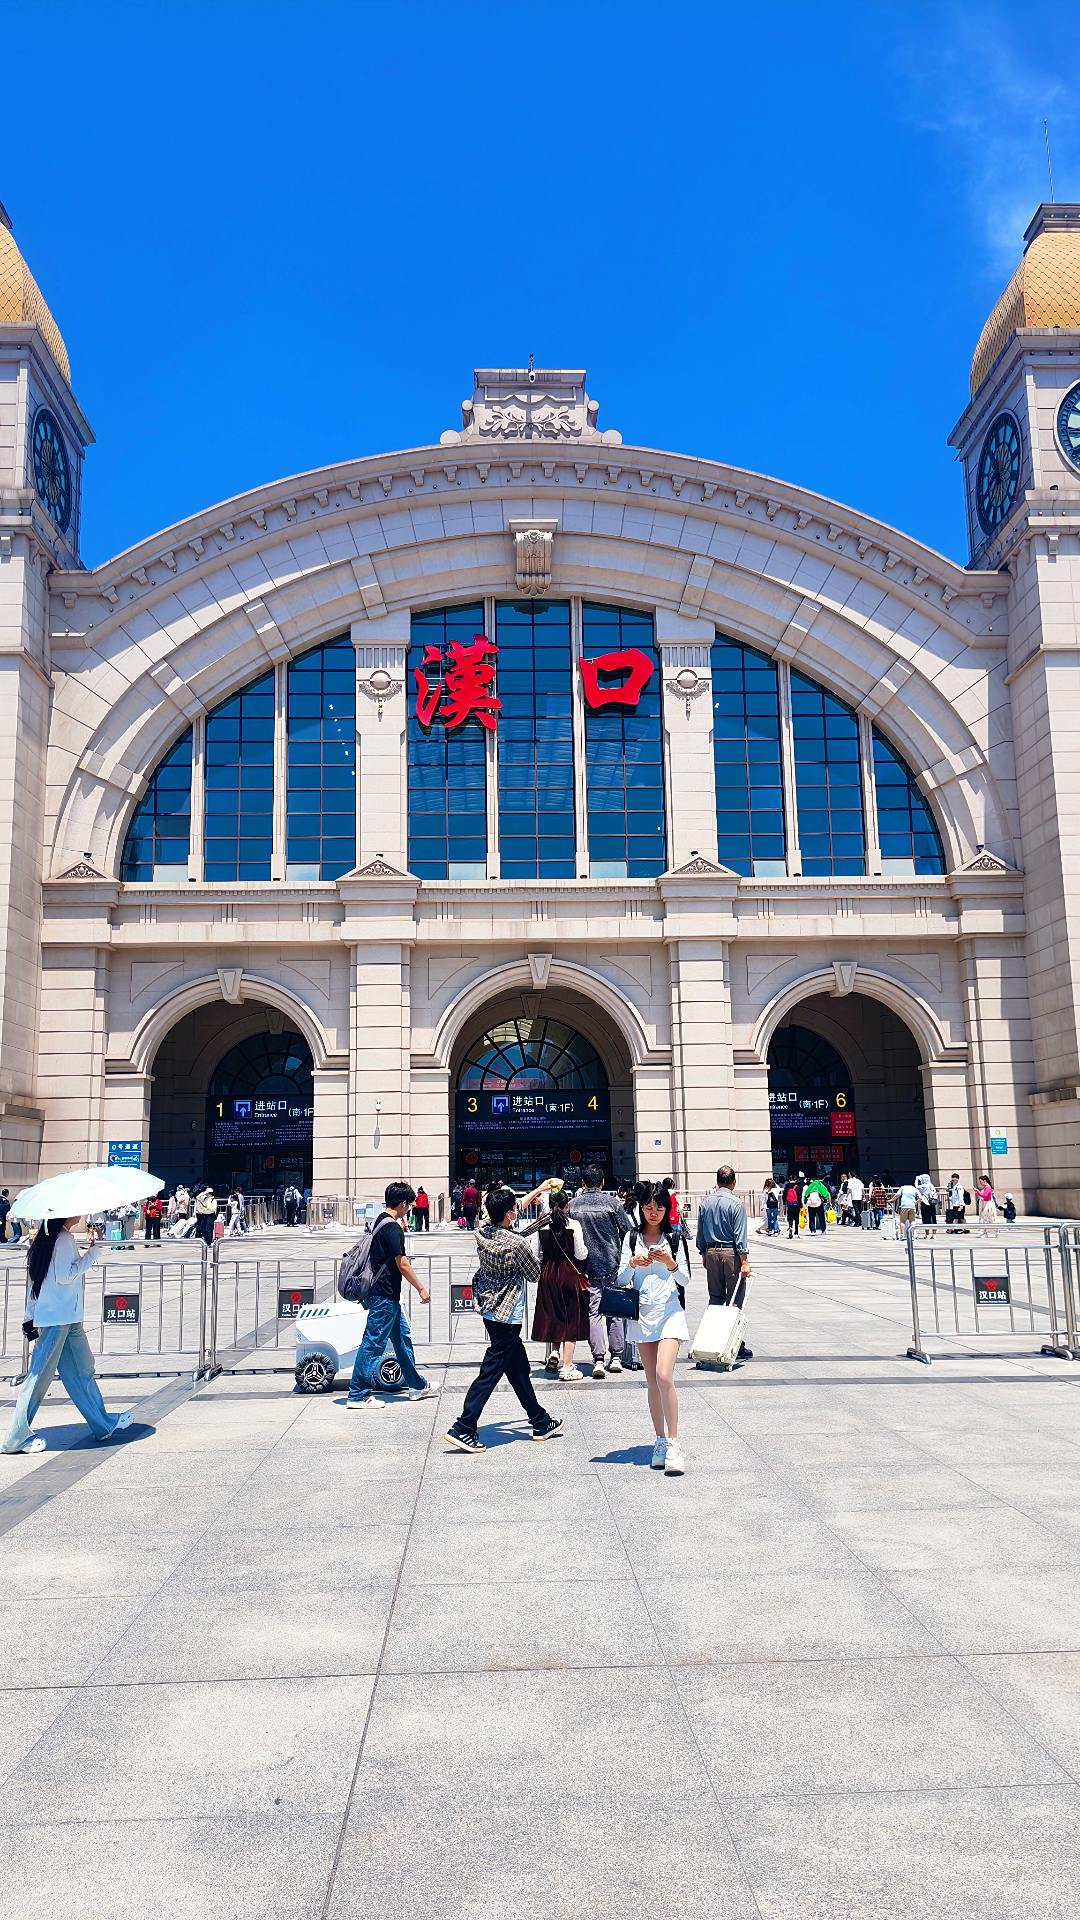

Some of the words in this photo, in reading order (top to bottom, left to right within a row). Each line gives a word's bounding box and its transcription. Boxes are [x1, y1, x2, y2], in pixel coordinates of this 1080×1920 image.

[414, 634, 655, 731] 漢口
[254, 1100, 287, 1111] 进站口
[467, 1097, 478, 1113] 3
[512, 1096, 544, 1107] 进站口
[587, 1095, 599, 1111] 4
[835, 1092, 847, 1108] 6
[215, 1102, 223, 1118] 1
[288, 1107, 315, 1117] (南·1F
[978, 1290, 1007, 1300] 汉口站
[454, 1299, 473, 1308] 汉口
[107, 1309, 136, 1319] 汉口站
